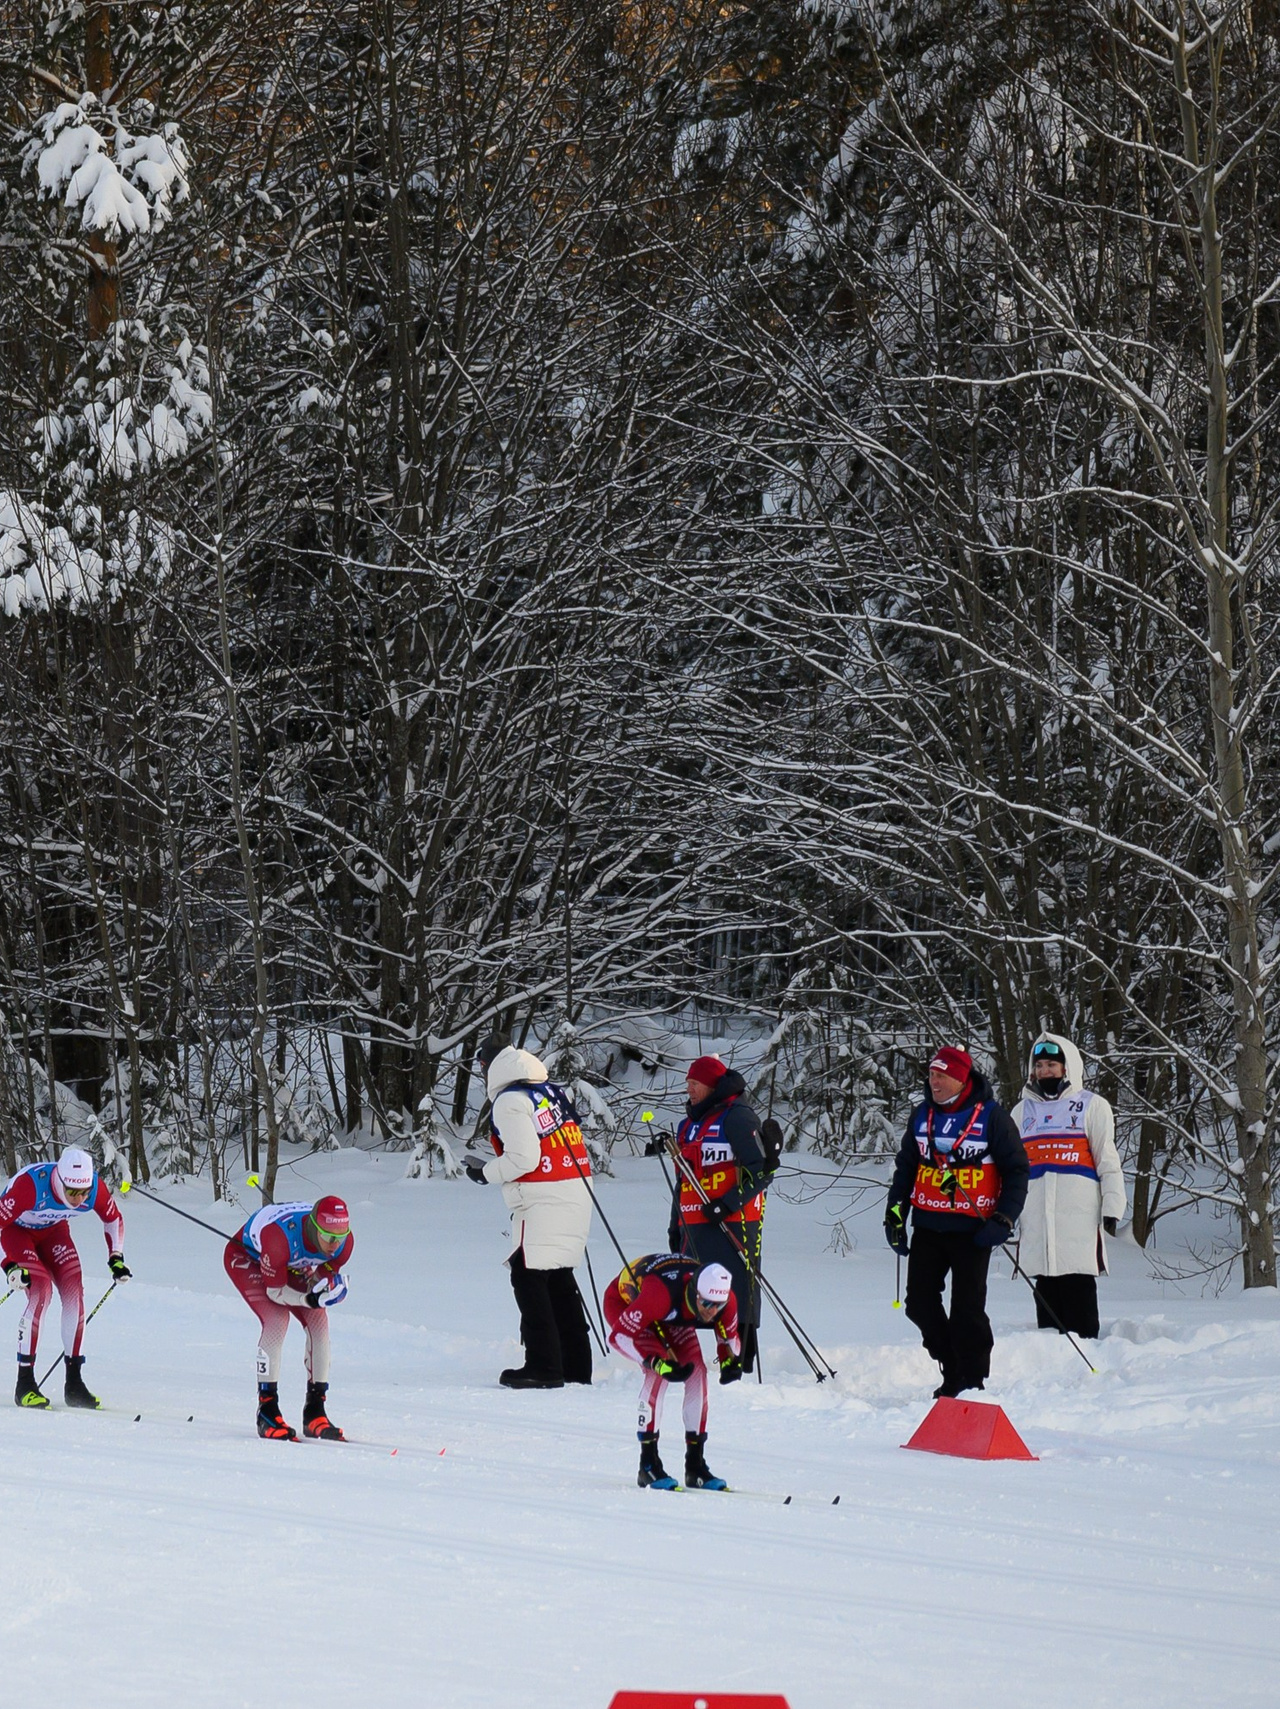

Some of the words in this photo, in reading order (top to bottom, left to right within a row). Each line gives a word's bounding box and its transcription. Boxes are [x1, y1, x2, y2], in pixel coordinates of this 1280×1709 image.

[1068, 1100, 1084, 1112] 79
[541, 1156, 553, 1173] 3
[917, 1164, 985, 1189] ТРЕЕР
[754, 1193, 761, 1211] 4
